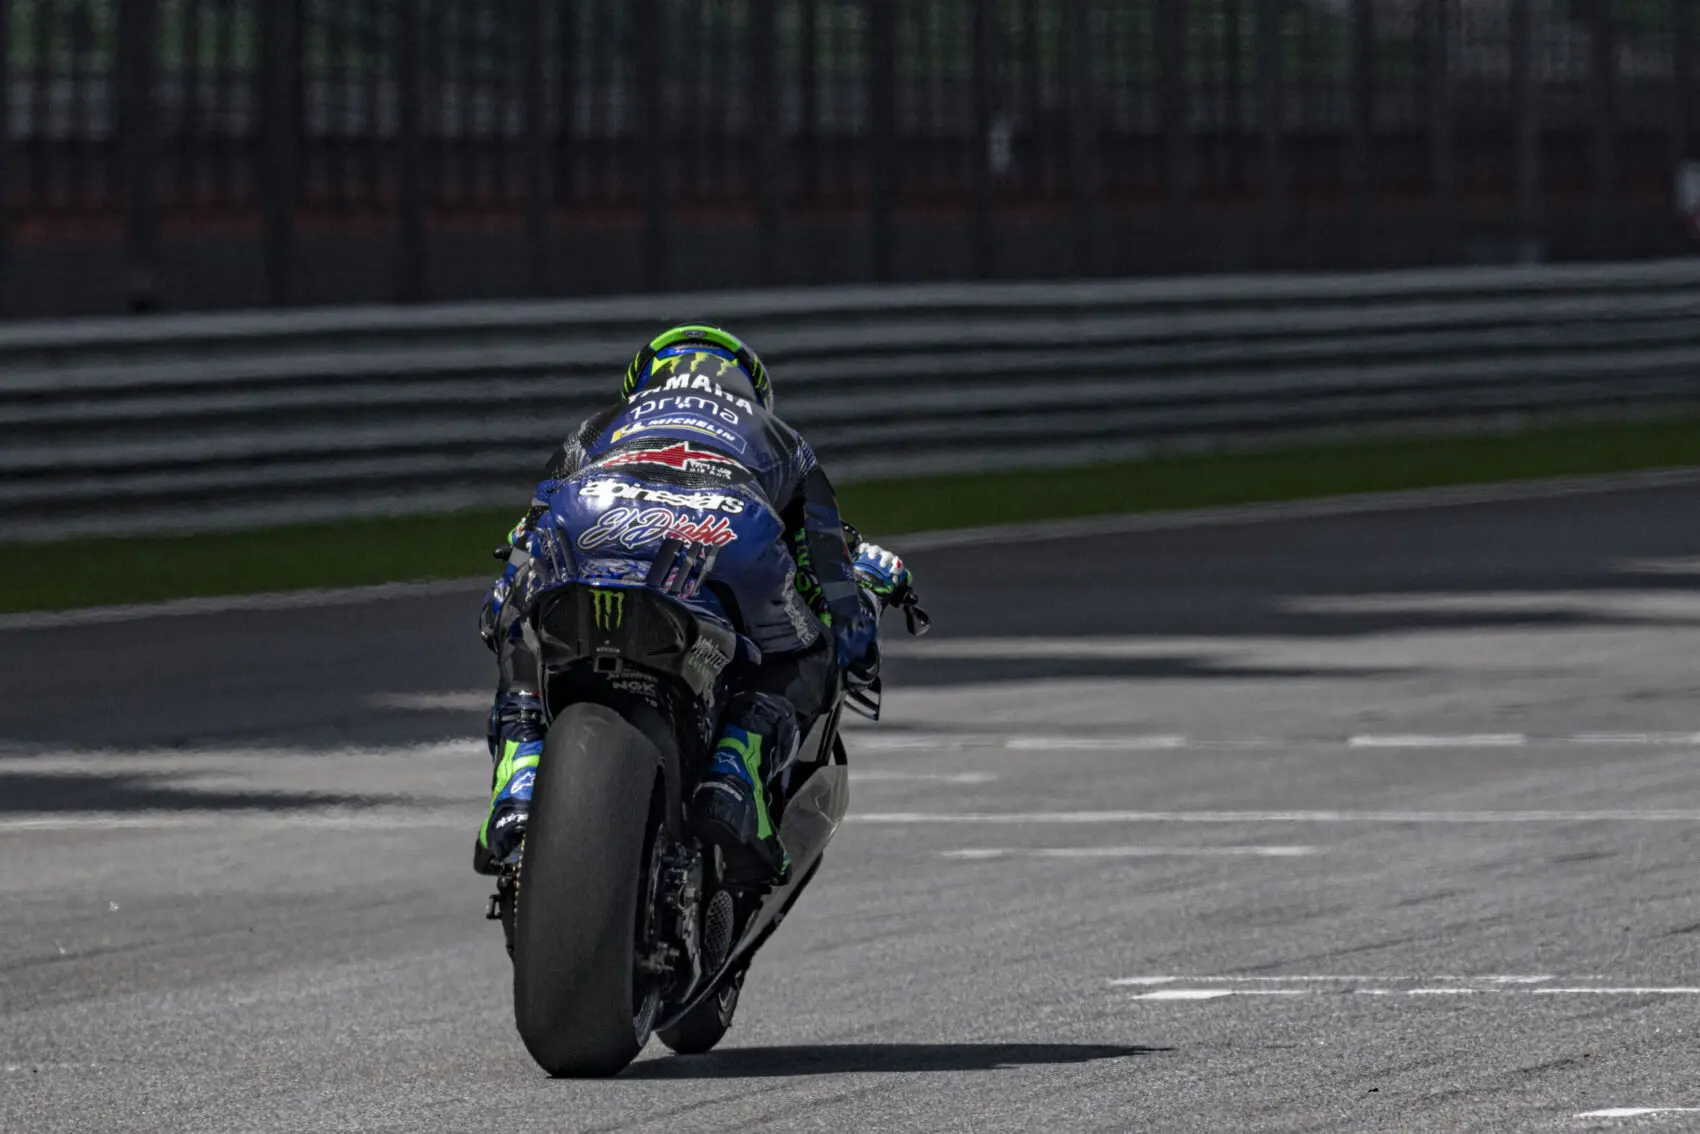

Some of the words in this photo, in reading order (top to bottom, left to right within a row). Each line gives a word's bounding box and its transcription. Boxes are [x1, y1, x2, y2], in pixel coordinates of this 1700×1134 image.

[630, 396, 739, 425] prima
[647, 417, 736, 441] MICHELIN
[578, 478, 745, 514] alpinestars
[578, 507, 635, 550] El
